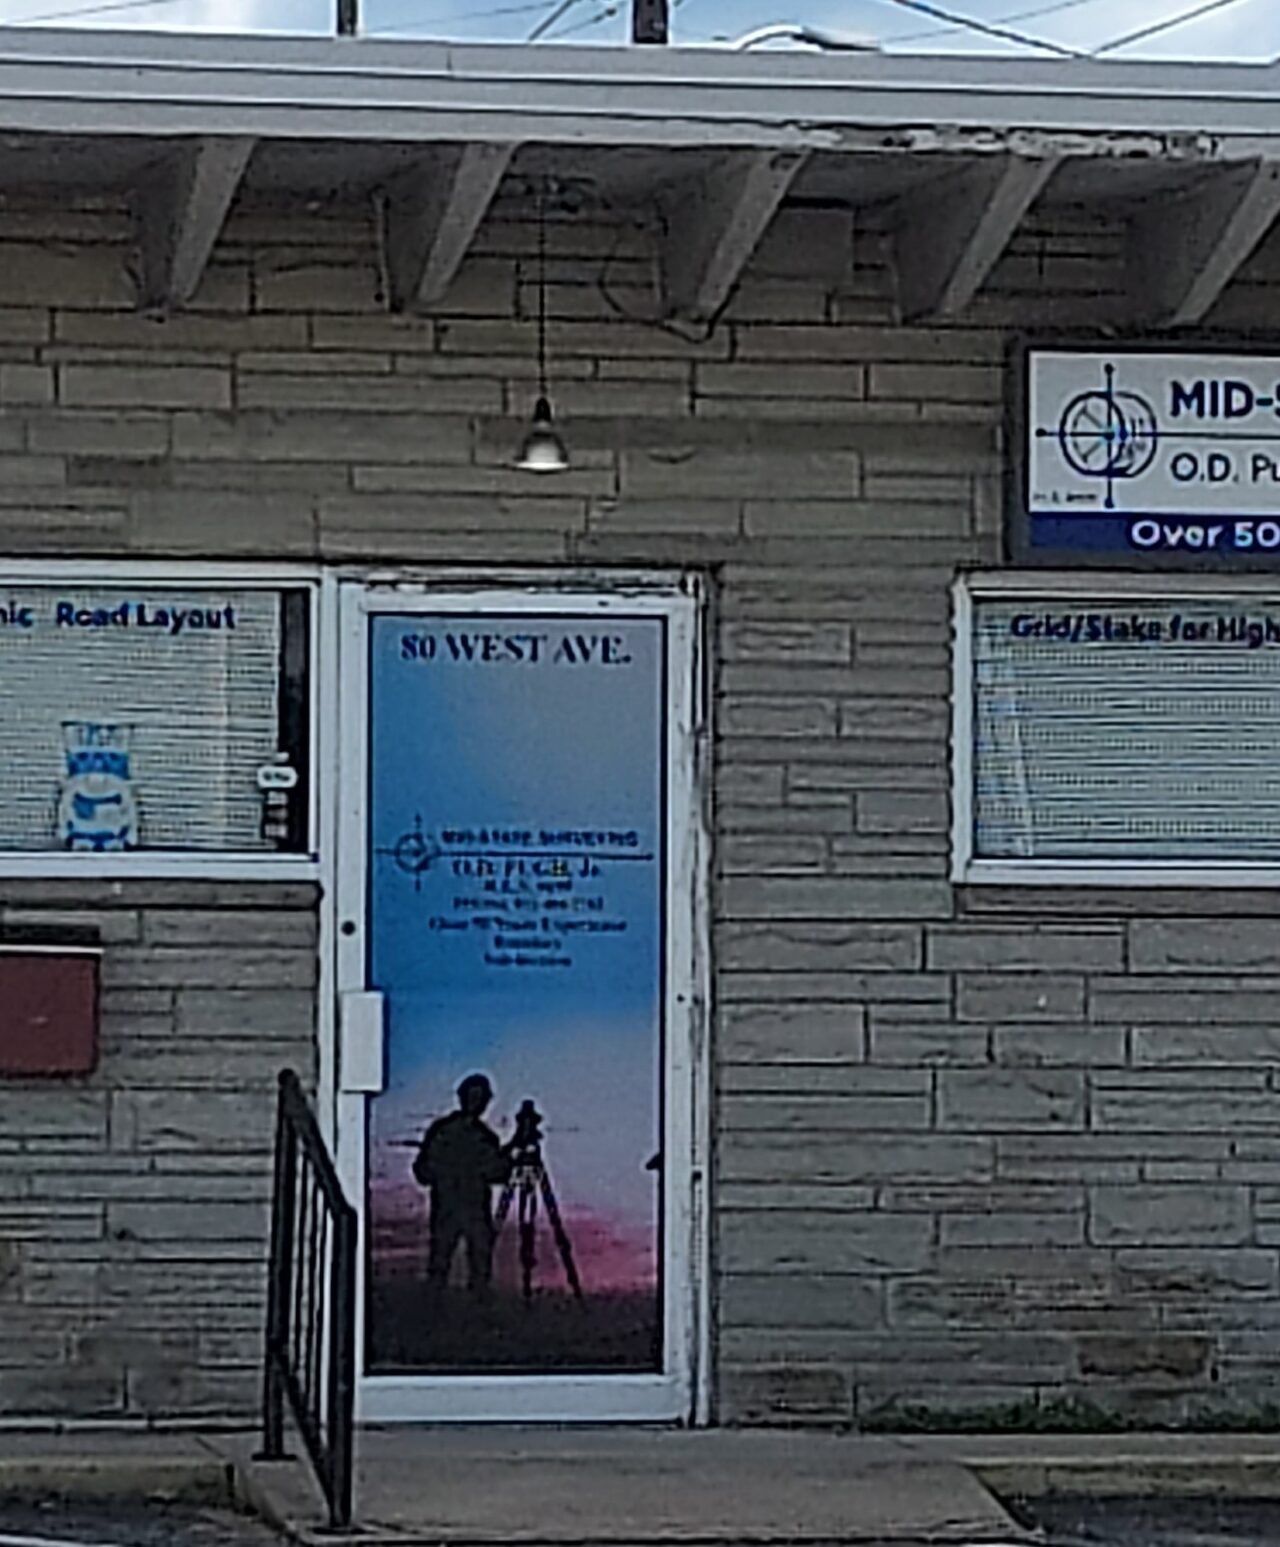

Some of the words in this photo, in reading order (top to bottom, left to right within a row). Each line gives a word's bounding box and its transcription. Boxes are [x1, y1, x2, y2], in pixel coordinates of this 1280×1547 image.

[1170, 451, 1239, 483] O.D.
[1130, 520, 1223, 549] Over
[56, 601, 129, 628] Road
[136, 603, 236, 635] Layout
[1169, 614, 1209, 641] for
[401, 633, 437, 661] 80
[445, 633, 548, 663] WEST
[553, 635, 632, 664] AVE.
